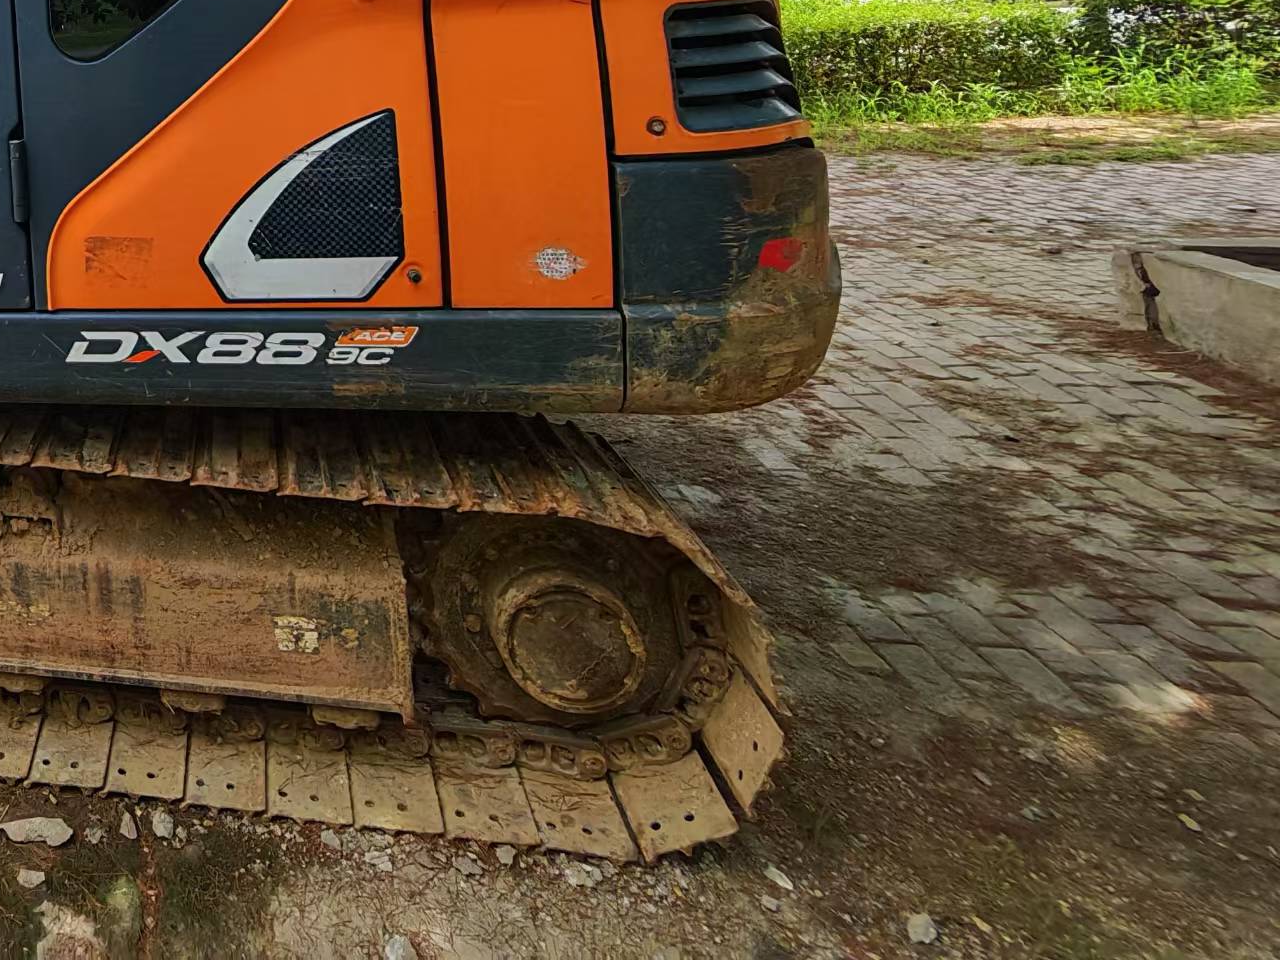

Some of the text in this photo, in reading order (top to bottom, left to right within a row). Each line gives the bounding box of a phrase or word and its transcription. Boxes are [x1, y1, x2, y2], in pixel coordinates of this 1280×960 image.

[353, 331, 406, 342] ACE
[65, 331, 395, 365] DX88 9C
